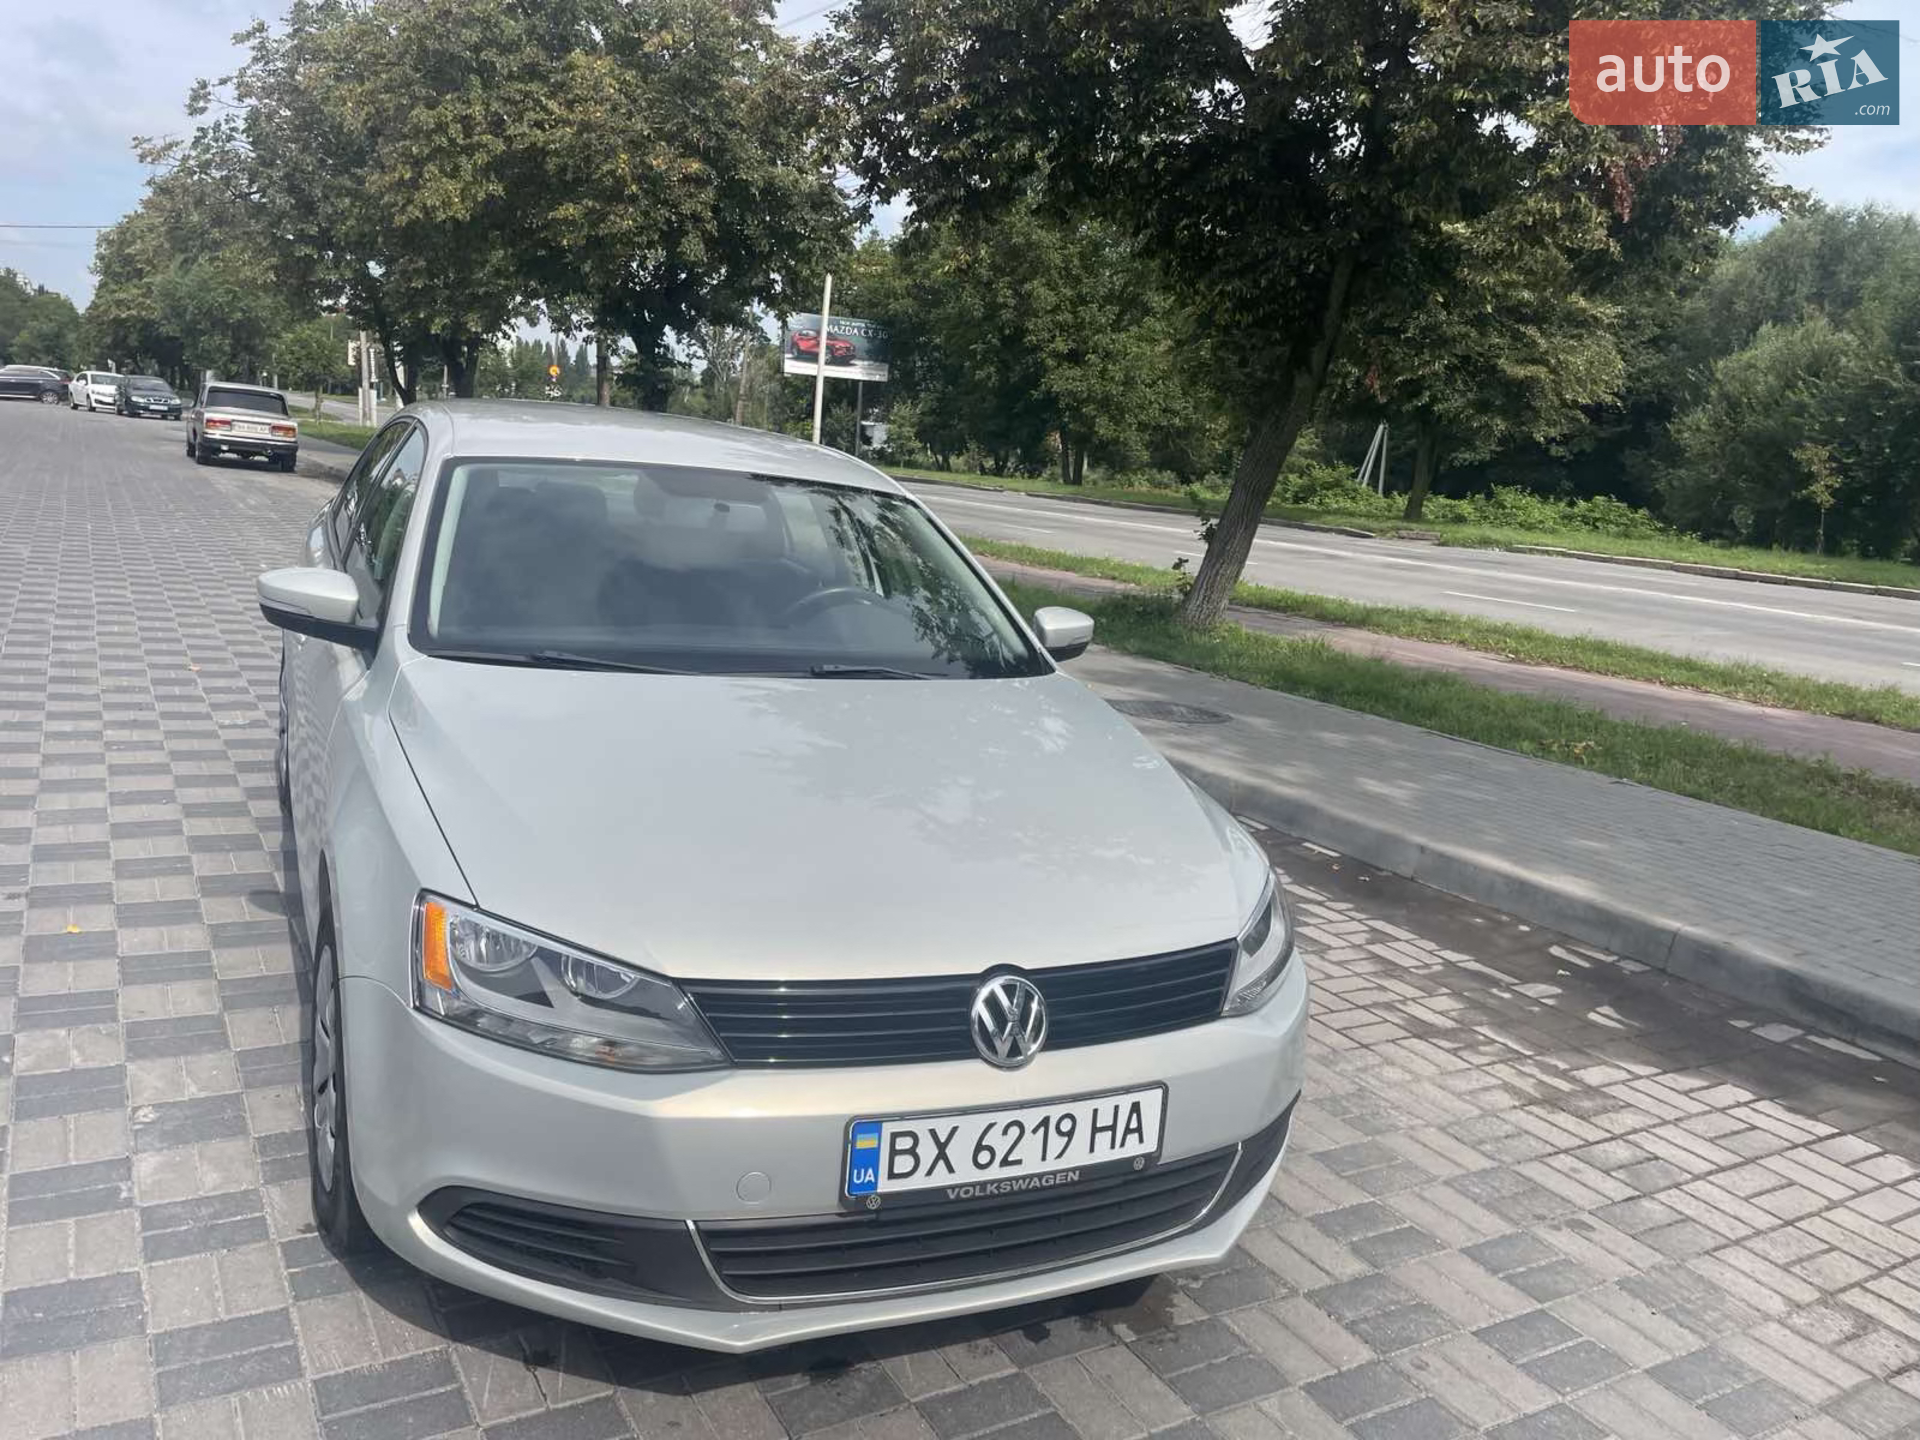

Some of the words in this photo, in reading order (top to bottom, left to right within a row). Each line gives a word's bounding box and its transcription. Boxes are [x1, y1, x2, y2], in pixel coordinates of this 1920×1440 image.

[826, 324, 859, 337] MAZDA
[887, 1125, 960, 1182] BX
[971, 1112, 1078, 1170] 6219
[1088, 1100, 1144, 1154] HA
[853, 1167, 875, 1185] UA
[946, 1169, 1081, 1199] VOLKSWAGEN
